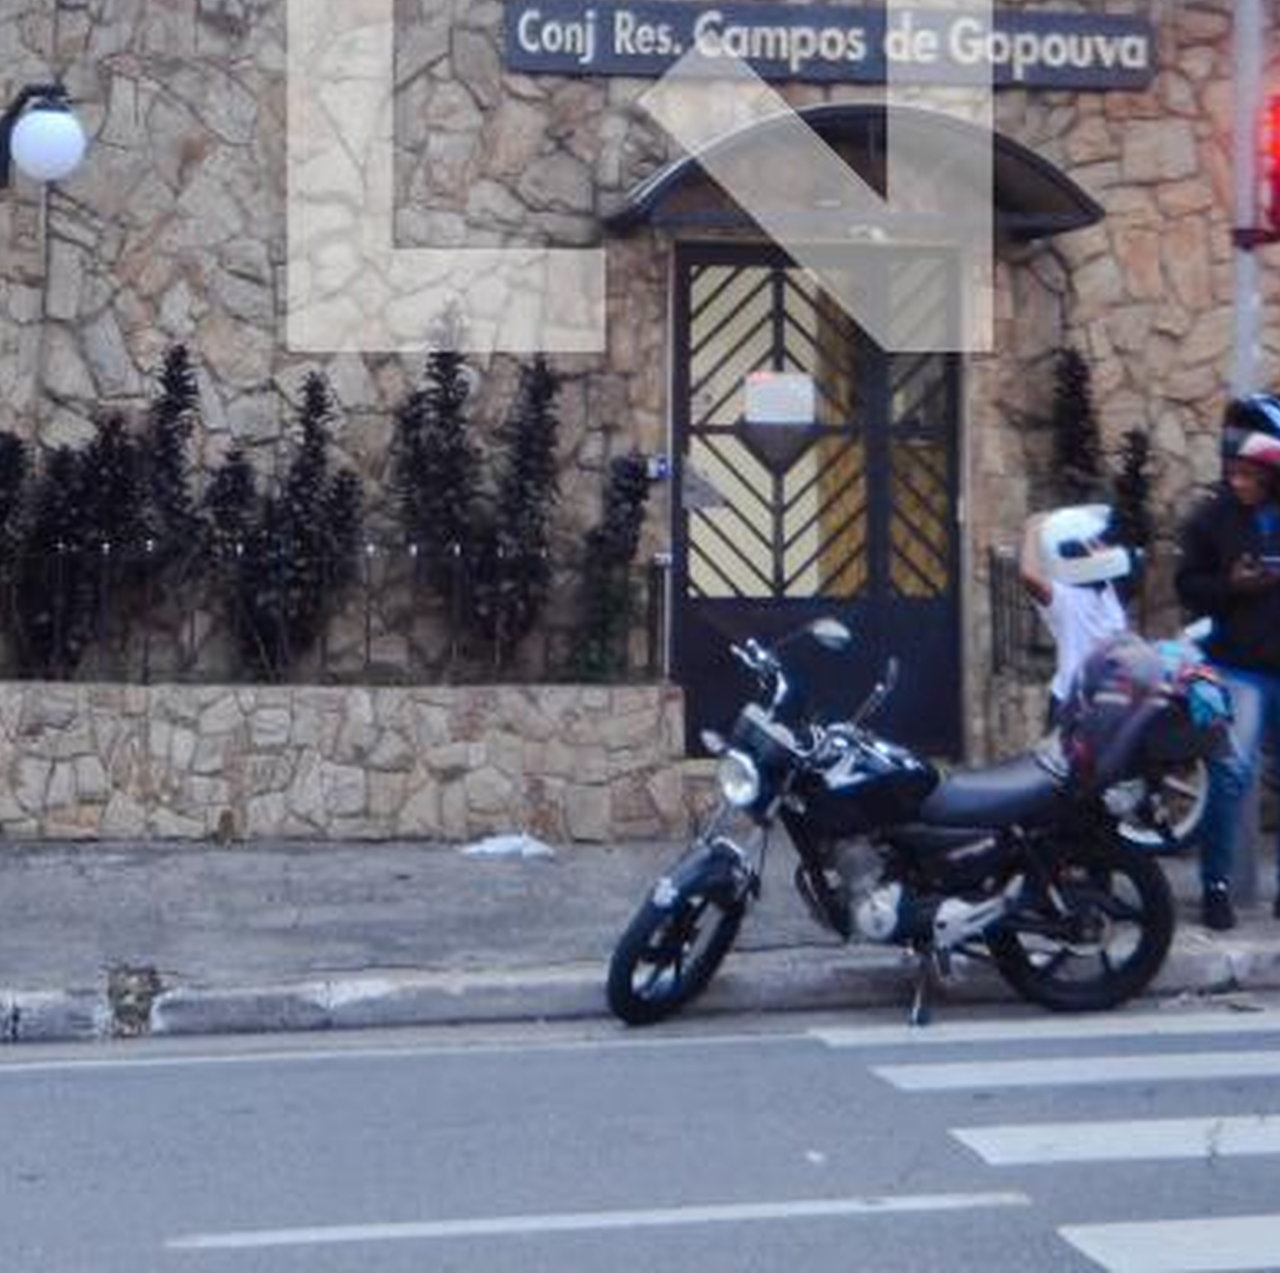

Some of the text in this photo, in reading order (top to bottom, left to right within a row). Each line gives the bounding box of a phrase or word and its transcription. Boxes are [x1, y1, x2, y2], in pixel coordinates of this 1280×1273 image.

[518, 9, 1147, 81] Conj Res. Campos de Gopouva
